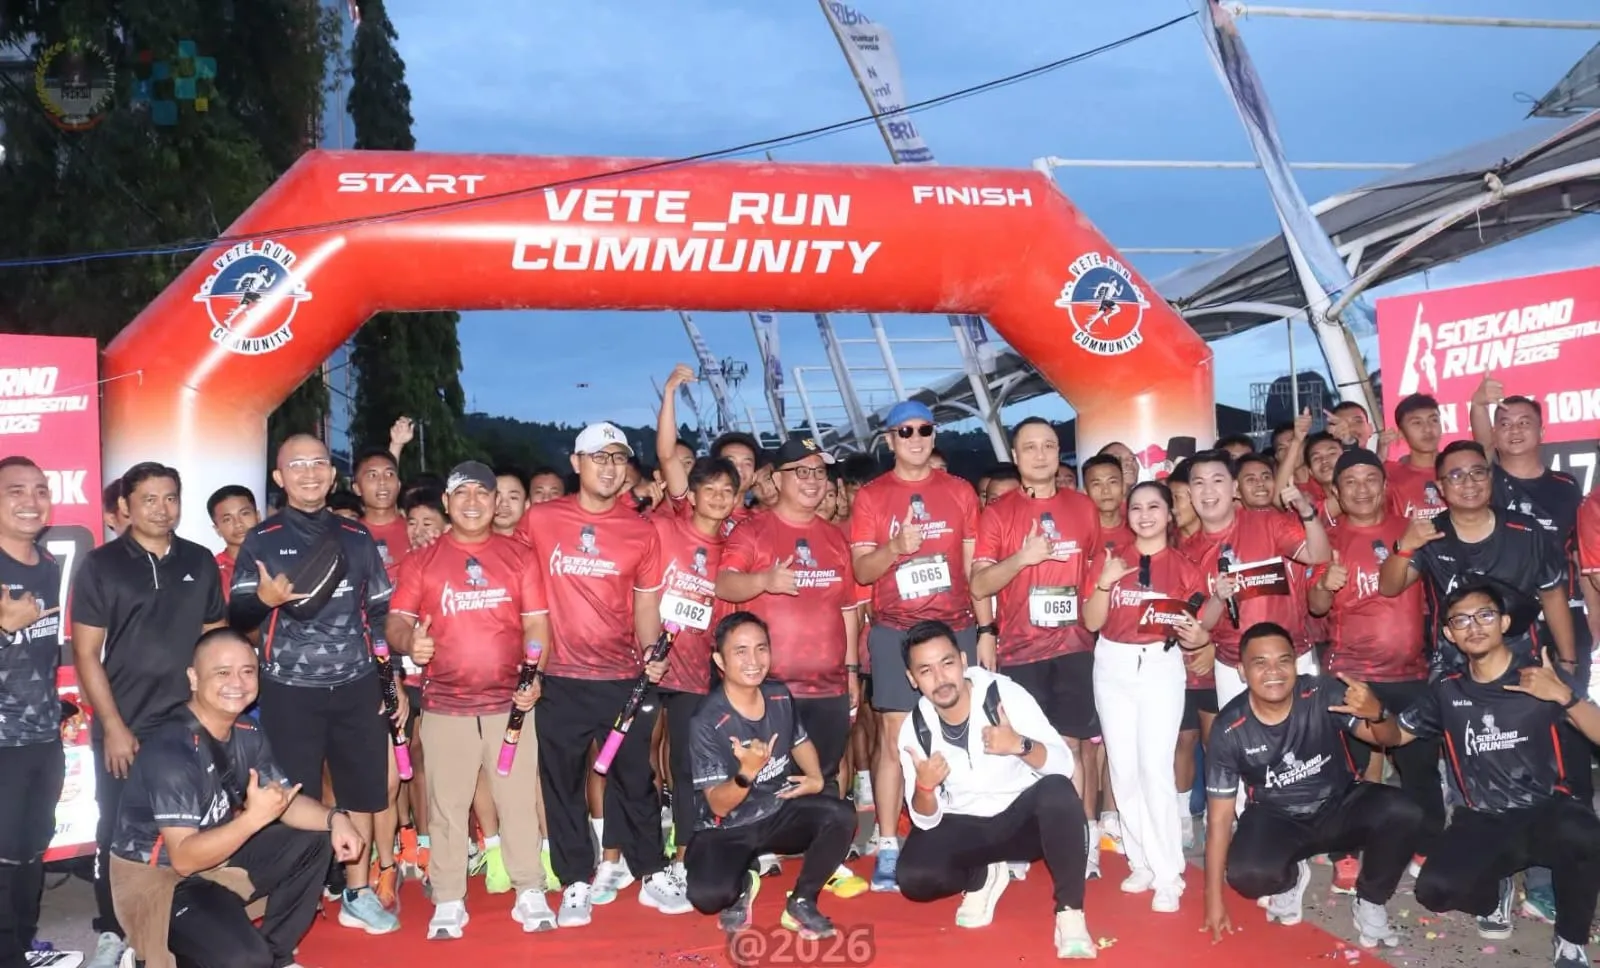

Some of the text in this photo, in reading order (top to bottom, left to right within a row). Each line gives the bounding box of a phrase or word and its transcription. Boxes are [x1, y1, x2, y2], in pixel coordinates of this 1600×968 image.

[337, 172, 486, 194] START
[912, 185, 1033, 207] FINISH
[511, 236, 882, 275] COMMUNITY
[1434, 297, 1575, 350] SOEKARNO
[213, 327, 291, 352] CMUNITY
[1074, 331, 1140, 353] COMMUNITY
[1442, 336, 1517, 379] RUN
[1545, 389, 1600, 424] 10K
[42, 469, 88, 505] 0K
[911, 566, 943, 585] 0665
[675, 601, 705, 622] 0462
[1044, 600, 1072, 615] 0653
[1478, 741, 1501, 752] RUN
